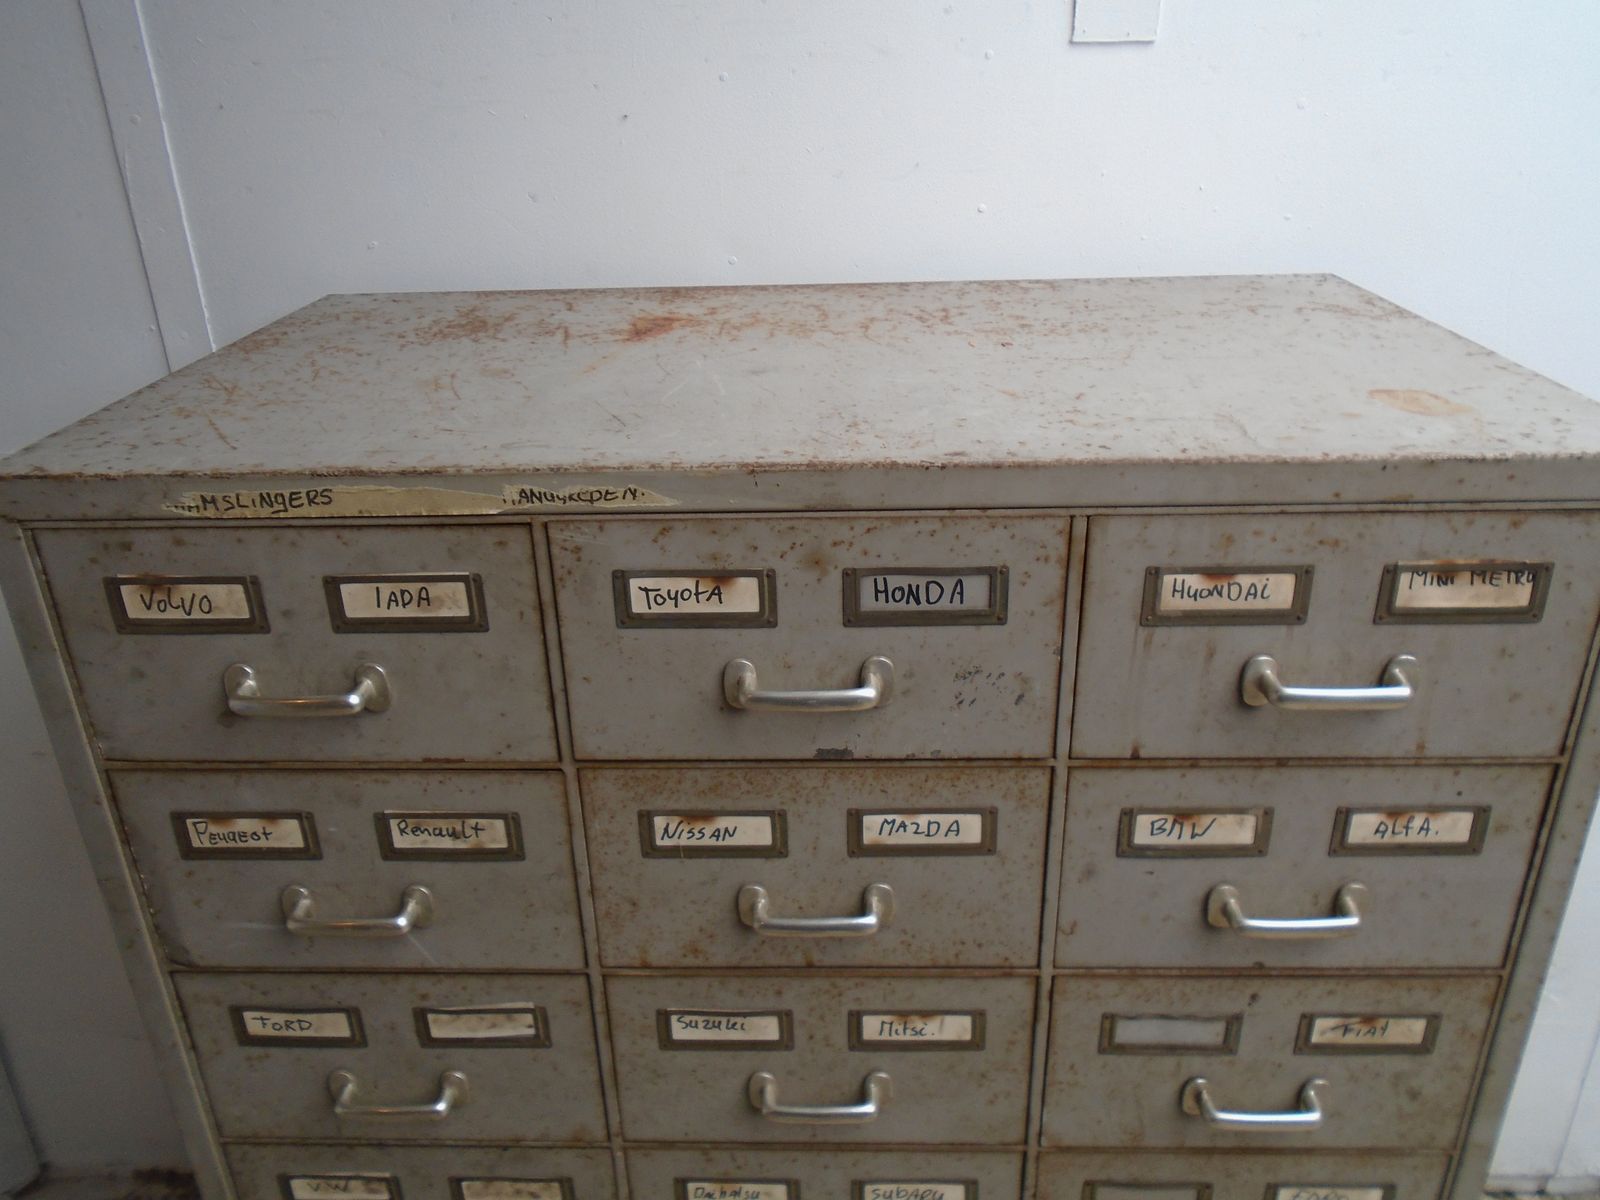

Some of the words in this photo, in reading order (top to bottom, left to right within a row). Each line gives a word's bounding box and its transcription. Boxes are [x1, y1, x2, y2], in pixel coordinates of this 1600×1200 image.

[873, 577, 966, 606] HONDA
[396, 819, 486, 840] Renault
[878, 817, 961, 838] MAZDA
[1150, 817, 1217, 840] BMW
